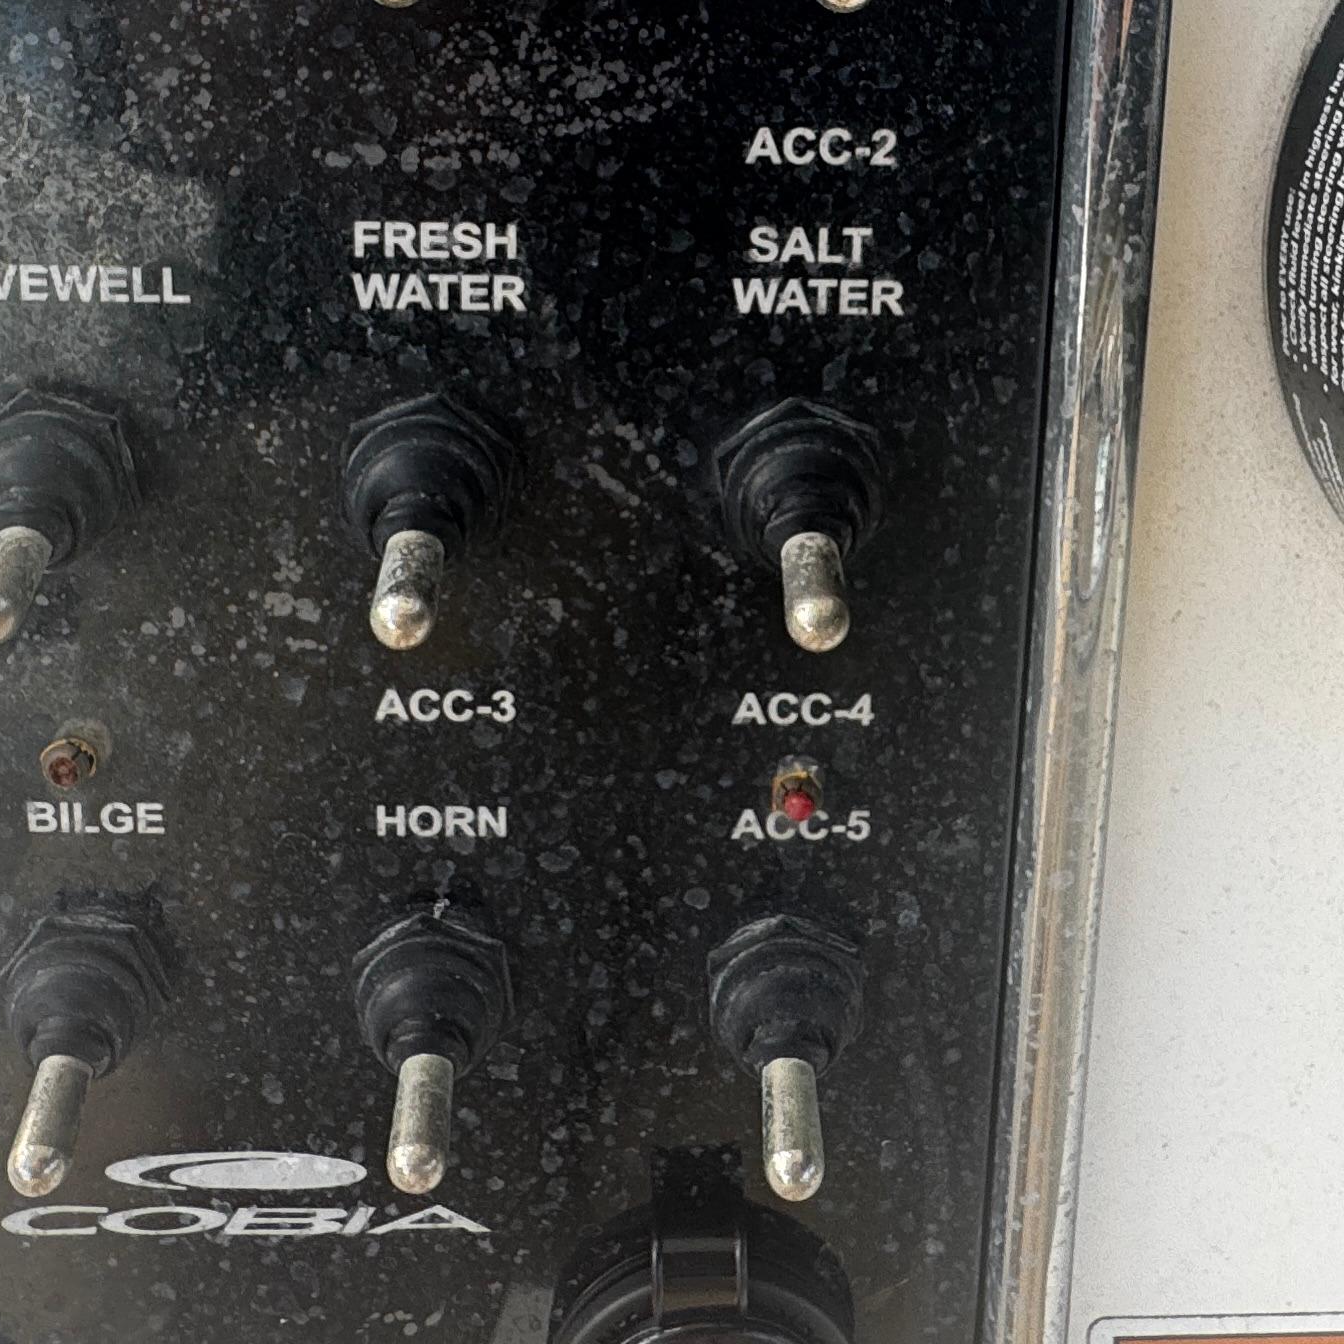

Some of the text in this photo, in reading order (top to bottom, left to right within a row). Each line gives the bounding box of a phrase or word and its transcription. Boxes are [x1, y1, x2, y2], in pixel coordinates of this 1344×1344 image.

[745, 127, 897, 166] ACC-2
[1305, 95, 1335, 168] highest
[1313, 110, 1343, 190] steering
[1300, 171, 1311, 190] in
[1316, 151, 1342, 234] steering
[1284, 187, 1296, 226] use:
[1291, 190, 1306, 240] level
[355, 221, 516, 259] FRESH
[749, 226, 873, 263] SALT
[1298, 192, 1318, 297] immediate
[1323, 191, 1344, 275] steering
[1278, 227, 1289, 288] EVERY
[1288, 241, 1299, 285] fluid
[1309, 236, 1323, 308] turning
[354, 273, 526, 311] WATER
[732, 278, 904, 316] WATER
[1280, 291, 1287, 310] to
[1319, 275, 1329, 303] all
[1288, 288, 1297, 345] Check
[1298, 298, 1308, 353] Verify
[1331, 301, 1340, 354] wear,
[1308, 311, 1318, 364] when
[1319, 303, 1329, 375] Inspect
[1330, 355, 1339, 386] for
[375, 689, 517, 723] ACC-3
[732, 692, 875, 726] ACC-4
[27, 801, 165, 835] BILGE
[376, 805, 507, 838] HORN
[731, 809, 871, 841] ACC-5
[0, 1204, 491, 1236] COBIA
